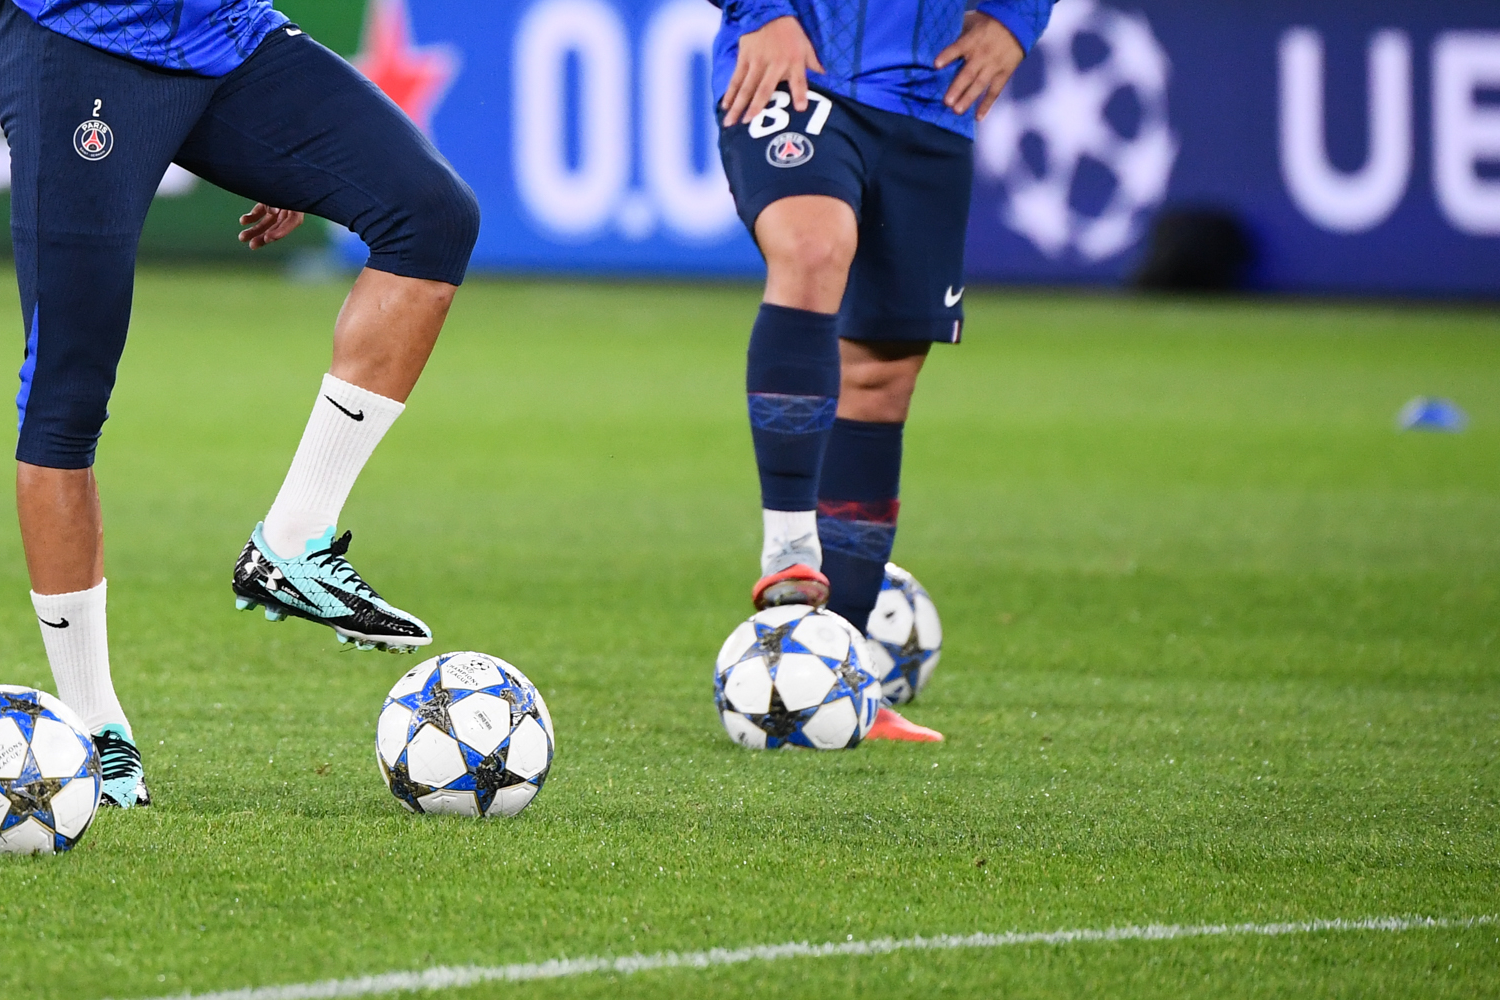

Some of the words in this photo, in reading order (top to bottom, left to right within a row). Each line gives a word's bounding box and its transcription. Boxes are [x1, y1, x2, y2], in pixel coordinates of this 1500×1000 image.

[92, 98, 102, 117] 2
[748, 90, 832, 139] 87
[81, 122, 108, 134] PARIS
